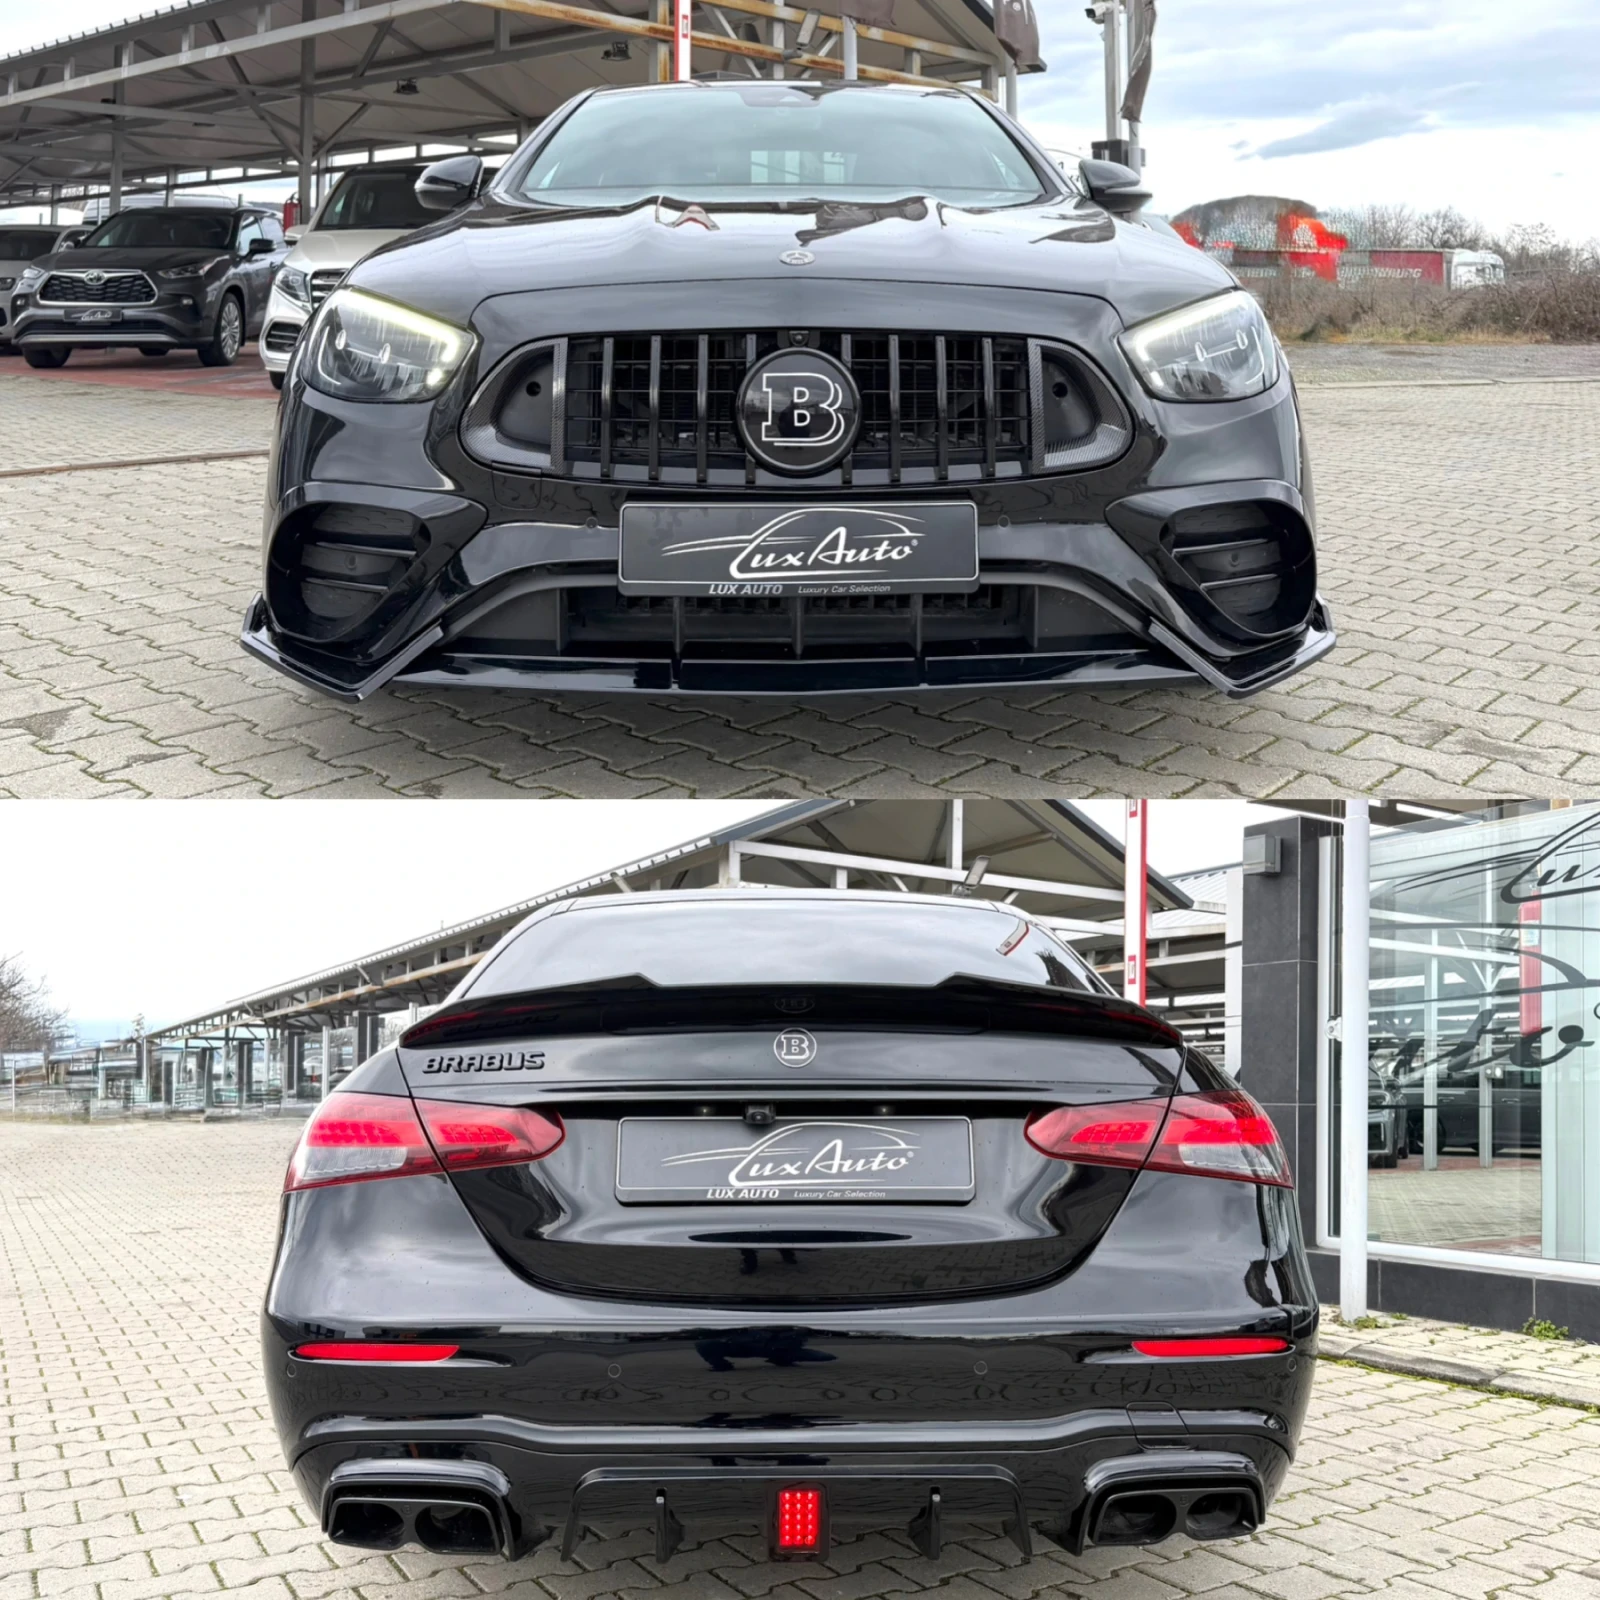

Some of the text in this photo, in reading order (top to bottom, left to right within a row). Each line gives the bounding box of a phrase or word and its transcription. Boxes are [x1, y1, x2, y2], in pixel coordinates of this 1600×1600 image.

[761, 372, 845, 446] B
[729, 536, 804, 580] Lux
[709, 584, 783, 595] LUX AUTO
[798, 583, 891, 594] Luxury Car Selection
[781, 1034, 809, 1059] B
[422, 1051, 546, 1074] BRABUS
[728, 1151, 803, 1187] Lux
[706, 1188, 780, 1199] LUX AUTO
[793, 1189, 886, 1199] Luxury Car Selection
